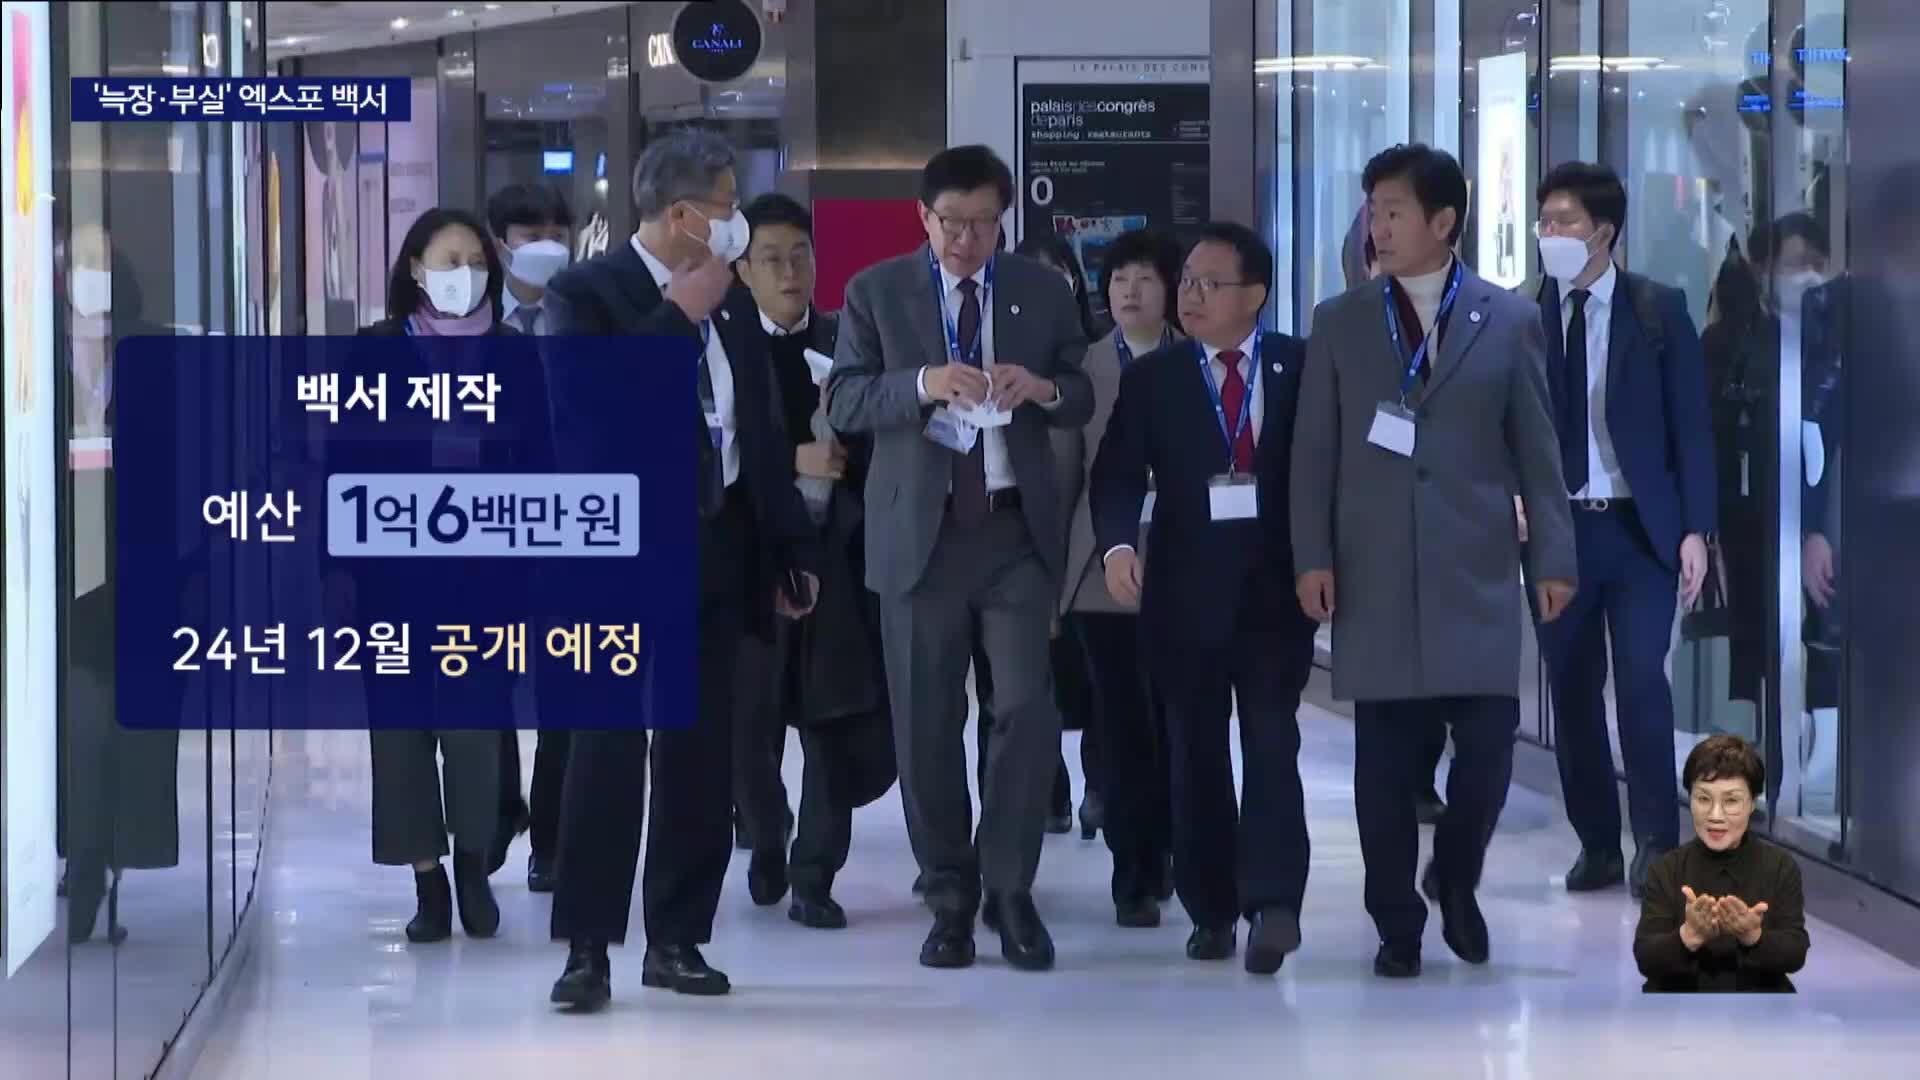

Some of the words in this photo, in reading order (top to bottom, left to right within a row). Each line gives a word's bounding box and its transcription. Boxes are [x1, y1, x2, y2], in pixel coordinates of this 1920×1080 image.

[692, 39, 744, 49] CANALI
[1031, 130, 1080, 140] shopping
[1087, 130, 1152, 139] restaurants
